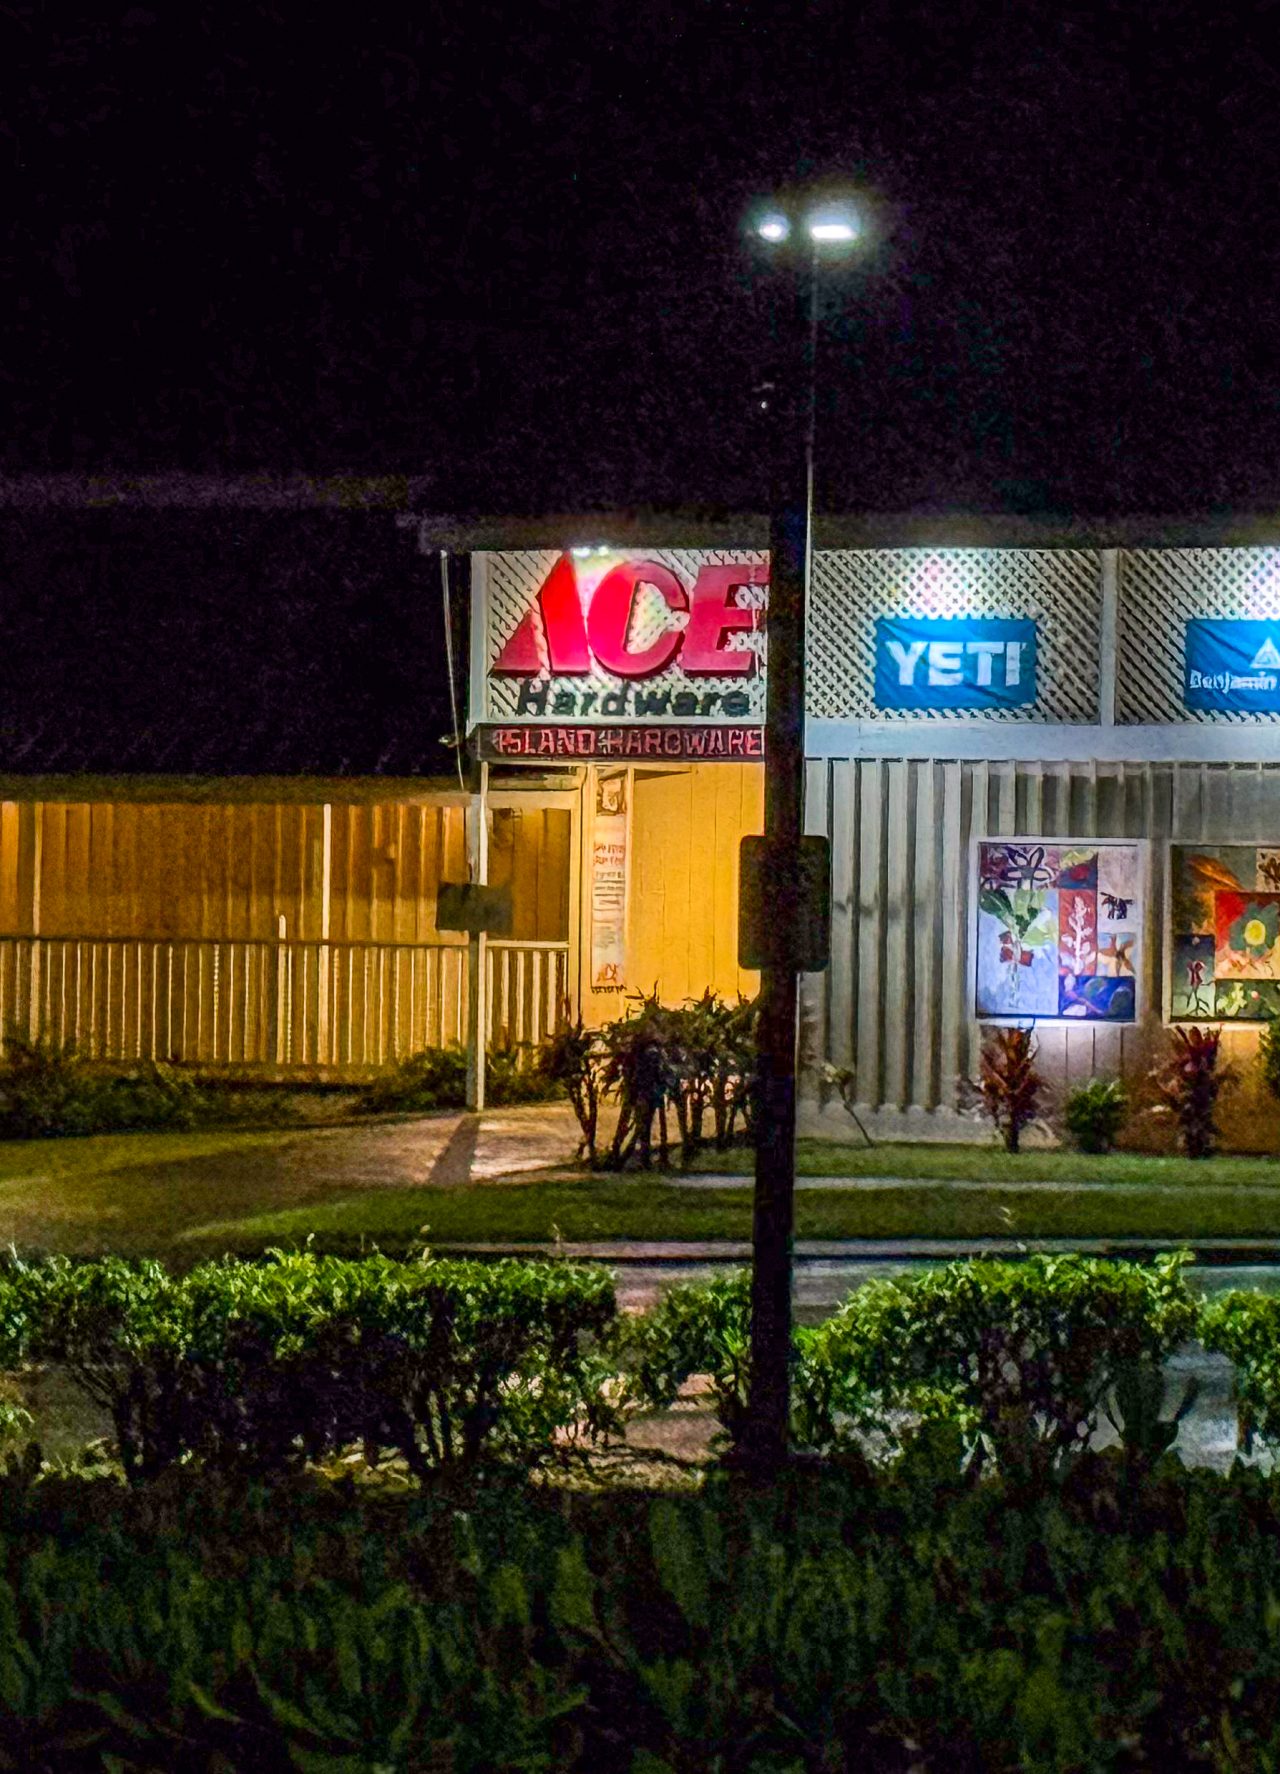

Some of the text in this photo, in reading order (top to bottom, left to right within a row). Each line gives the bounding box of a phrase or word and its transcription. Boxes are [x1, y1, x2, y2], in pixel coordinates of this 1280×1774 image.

[490, 550, 768, 676] ACE
[885, 641, 1021, 686] YETI
[1190, 669, 1277, 694] Benjamin
[516, 676, 750, 717] Hardware
[493, 728, 762, 757] ISLAND HARDWARE
